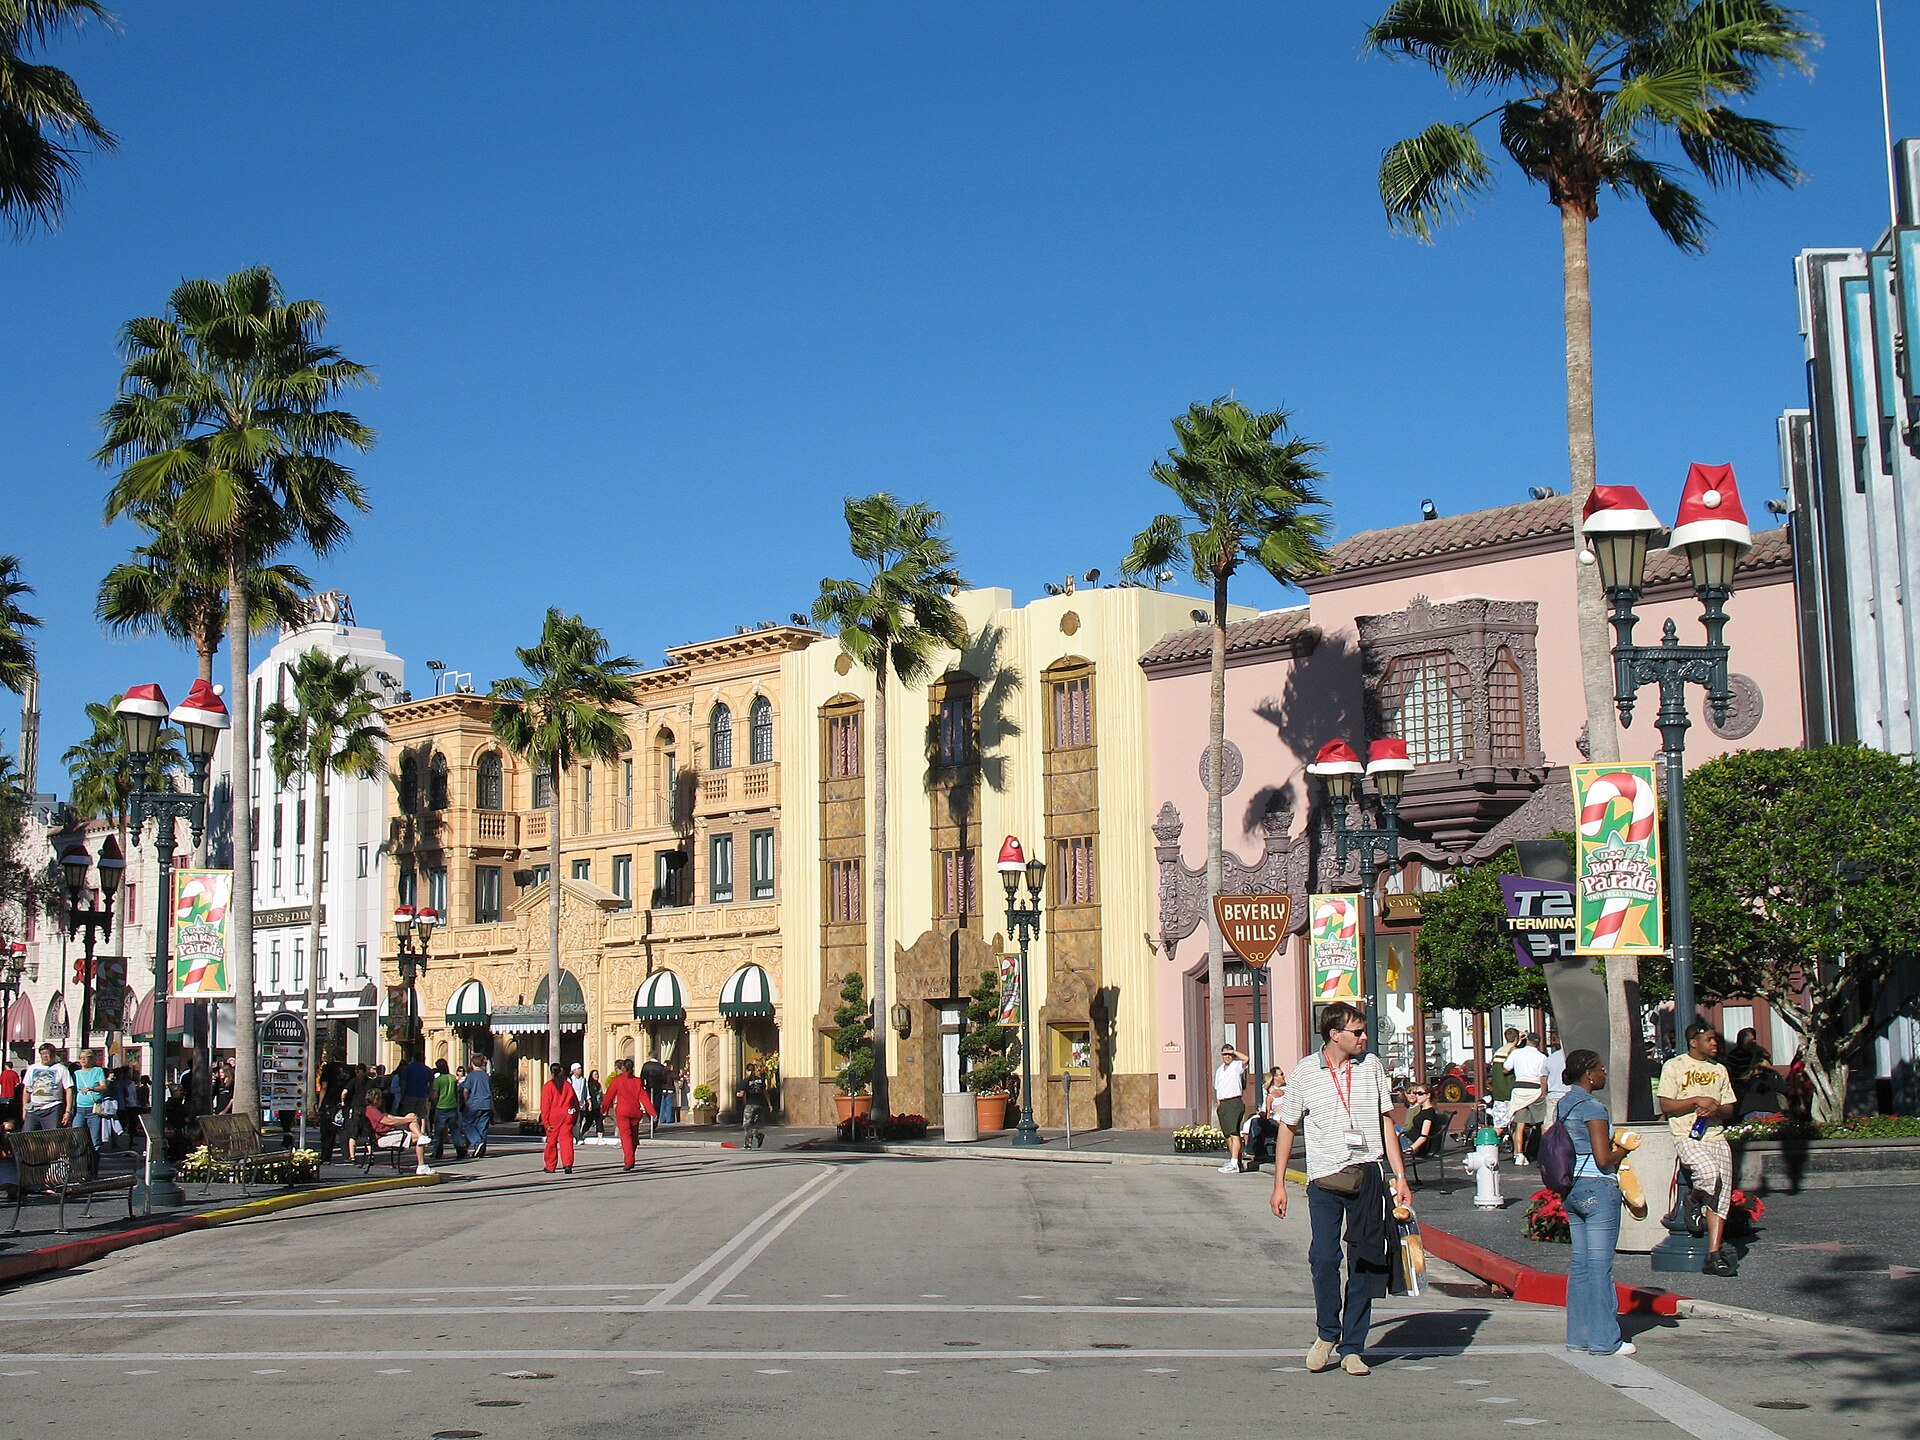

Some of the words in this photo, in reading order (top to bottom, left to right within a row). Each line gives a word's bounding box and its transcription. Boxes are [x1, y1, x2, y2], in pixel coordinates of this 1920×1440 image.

[1589, 859, 1648, 876] Holiday
[1580, 871, 1657, 896] Parade
[1514, 890, 1574, 916] T2
[1587, 890, 1625, 901] UNIVERSAL
[1625, 889, 1653, 900] STUDIOS
[1224, 903, 1285, 921] BEVERLY
[1235, 924, 1277, 941] HILLS
[177, 941, 224, 957] Parade
[1315, 955, 1358, 968] Parade
[274, 1020, 297, 1028] STUDIO
[267, 1028, 302, 1037] DIRECTORY
